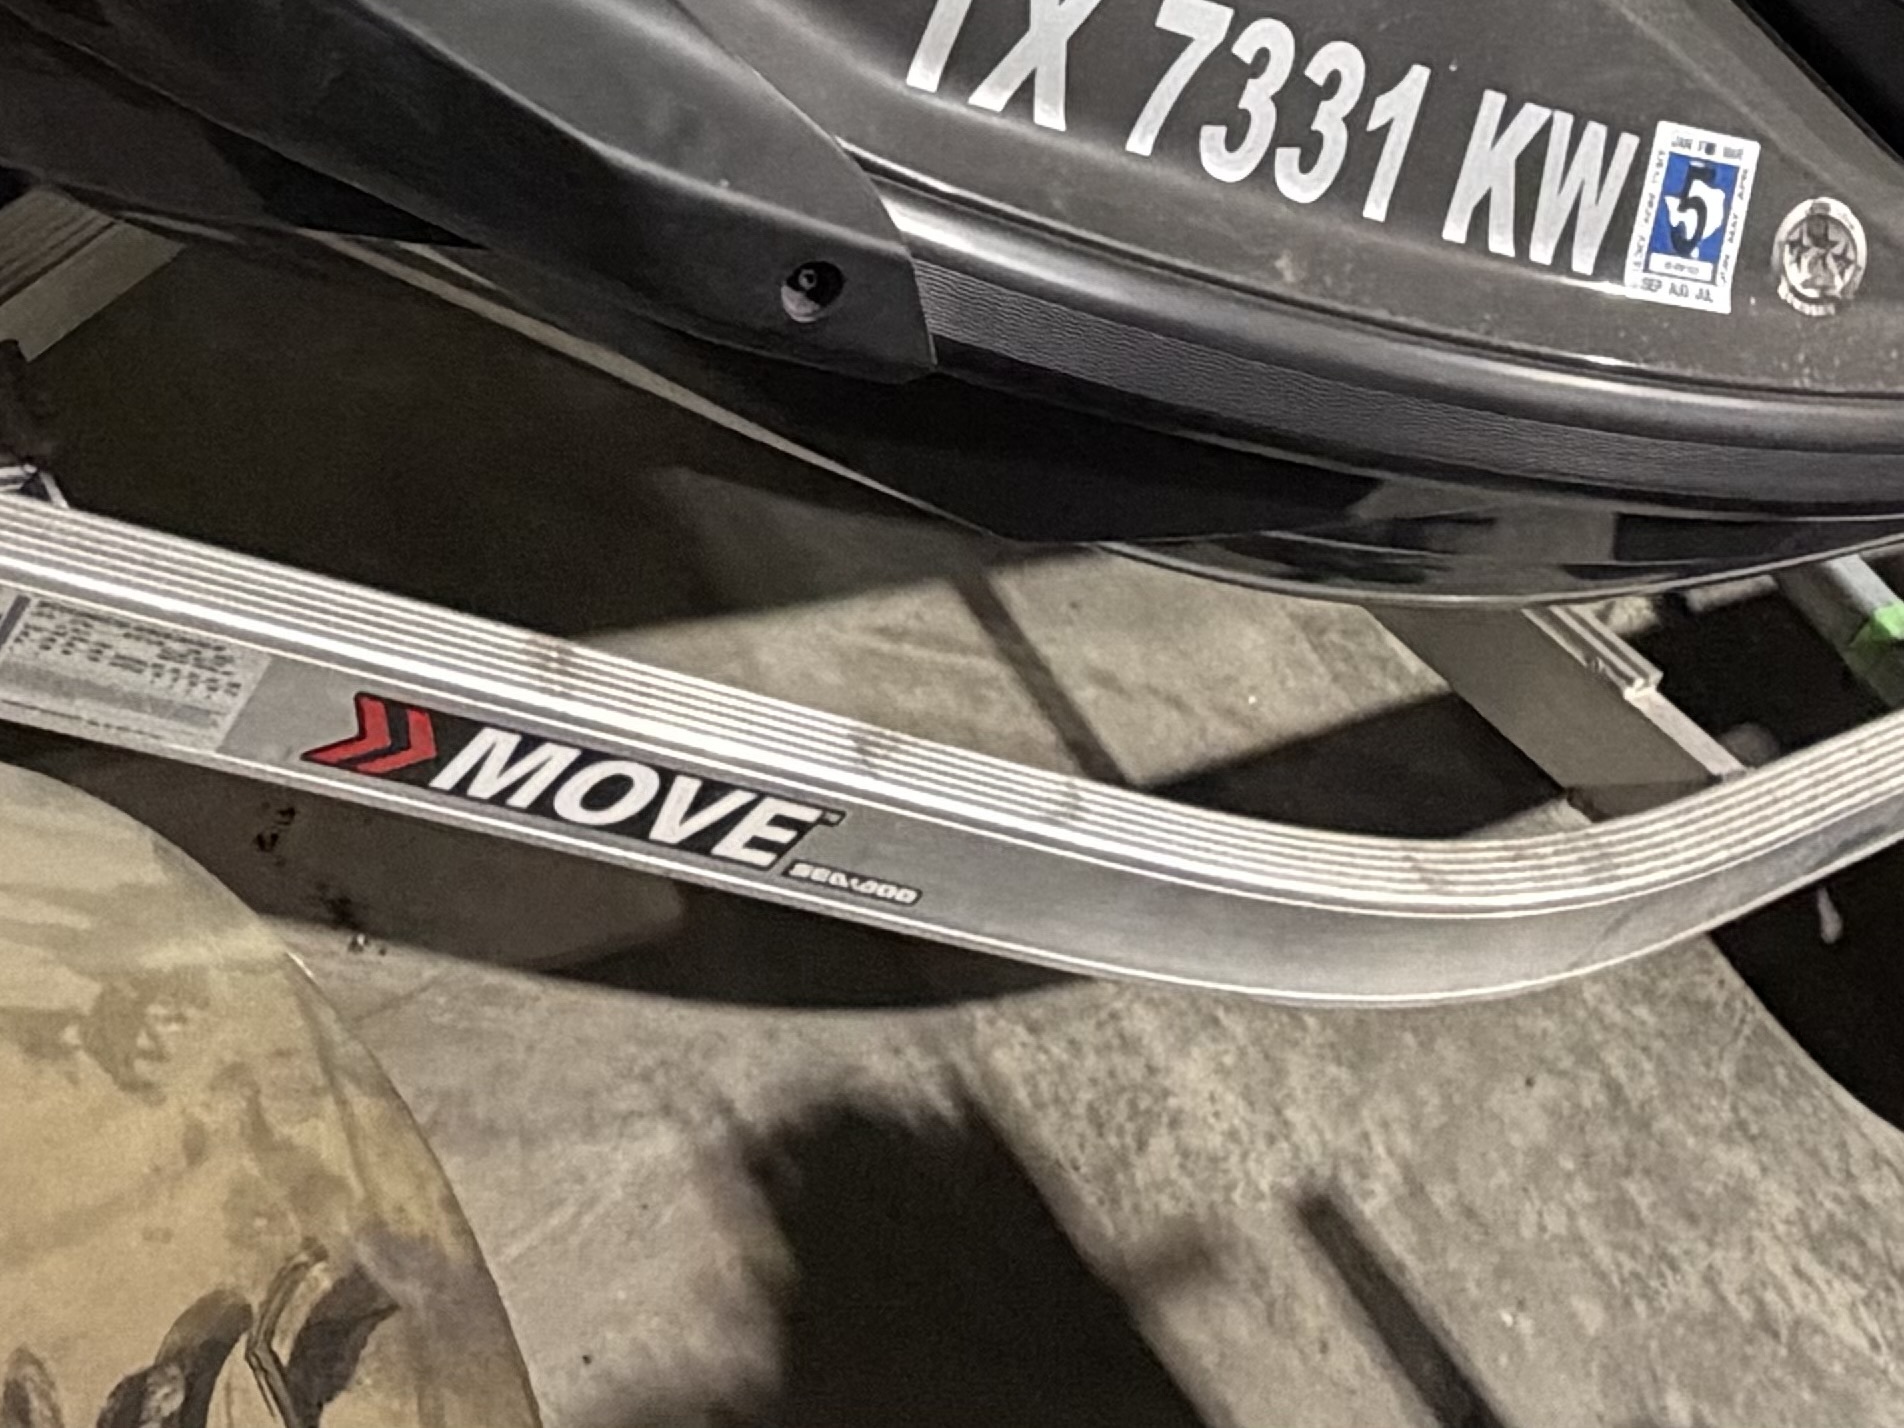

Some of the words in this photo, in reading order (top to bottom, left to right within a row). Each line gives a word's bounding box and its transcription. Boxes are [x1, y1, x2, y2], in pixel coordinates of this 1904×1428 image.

[1441, 88, 1641, 276] KW
[1670, 163, 1717, 258] 5
[428, 726, 823, 867] MOVE
